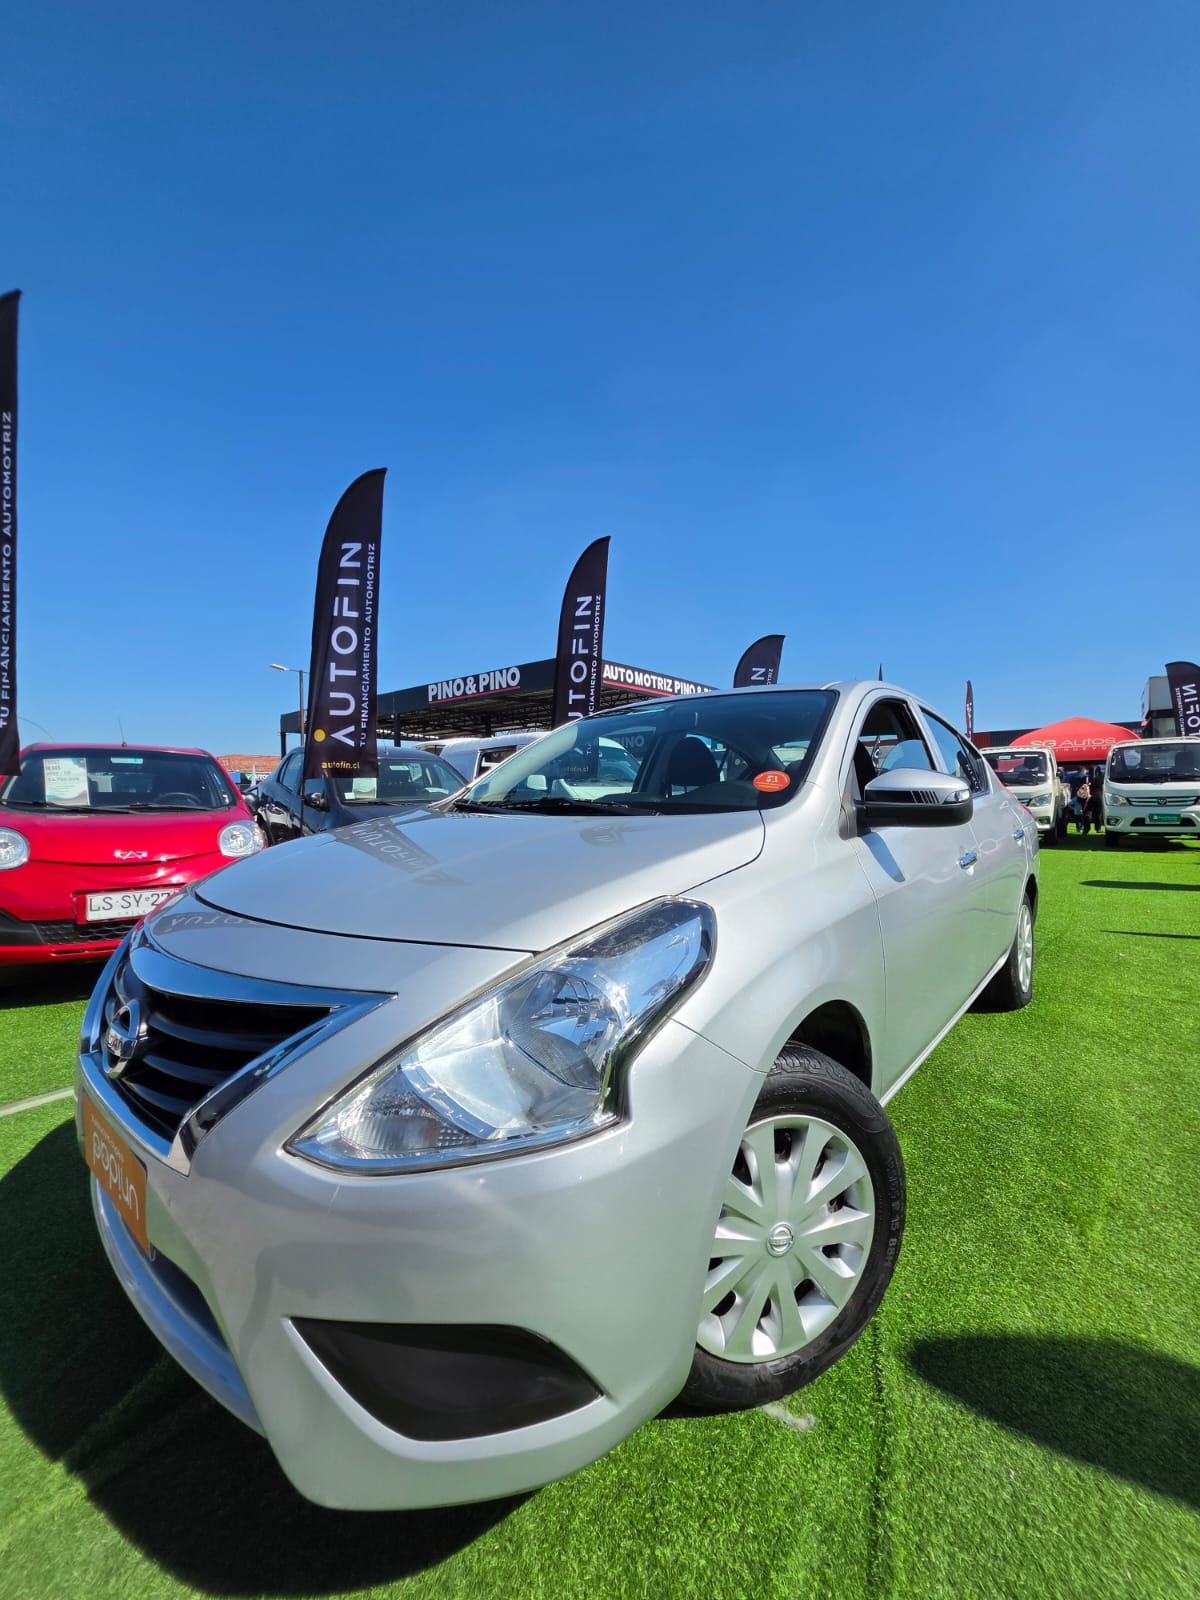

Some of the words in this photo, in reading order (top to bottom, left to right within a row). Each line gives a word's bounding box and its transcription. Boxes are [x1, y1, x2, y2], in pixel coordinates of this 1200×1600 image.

[3, 412, 12, 537] AUTOMOTRIZ
[365, 543, 375, 623] AUTOMOTRIZ
[1, 544, 12, 700] FINANCIAMIENTO
[329, 542, 362, 748] AUTOFIN
[592, 595, 602, 657] AUTOMOTRIZ
[361, 627, 371, 729] FINANCIAMIENTO
[603, 664, 673, 692] AUTOMOTRIZ
[674, 680, 696, 696] PINO
[0, 706, 10, 728] TU
[360, 732, 367, 747] TU
[322, 761, 360, 769] autofin.cl
